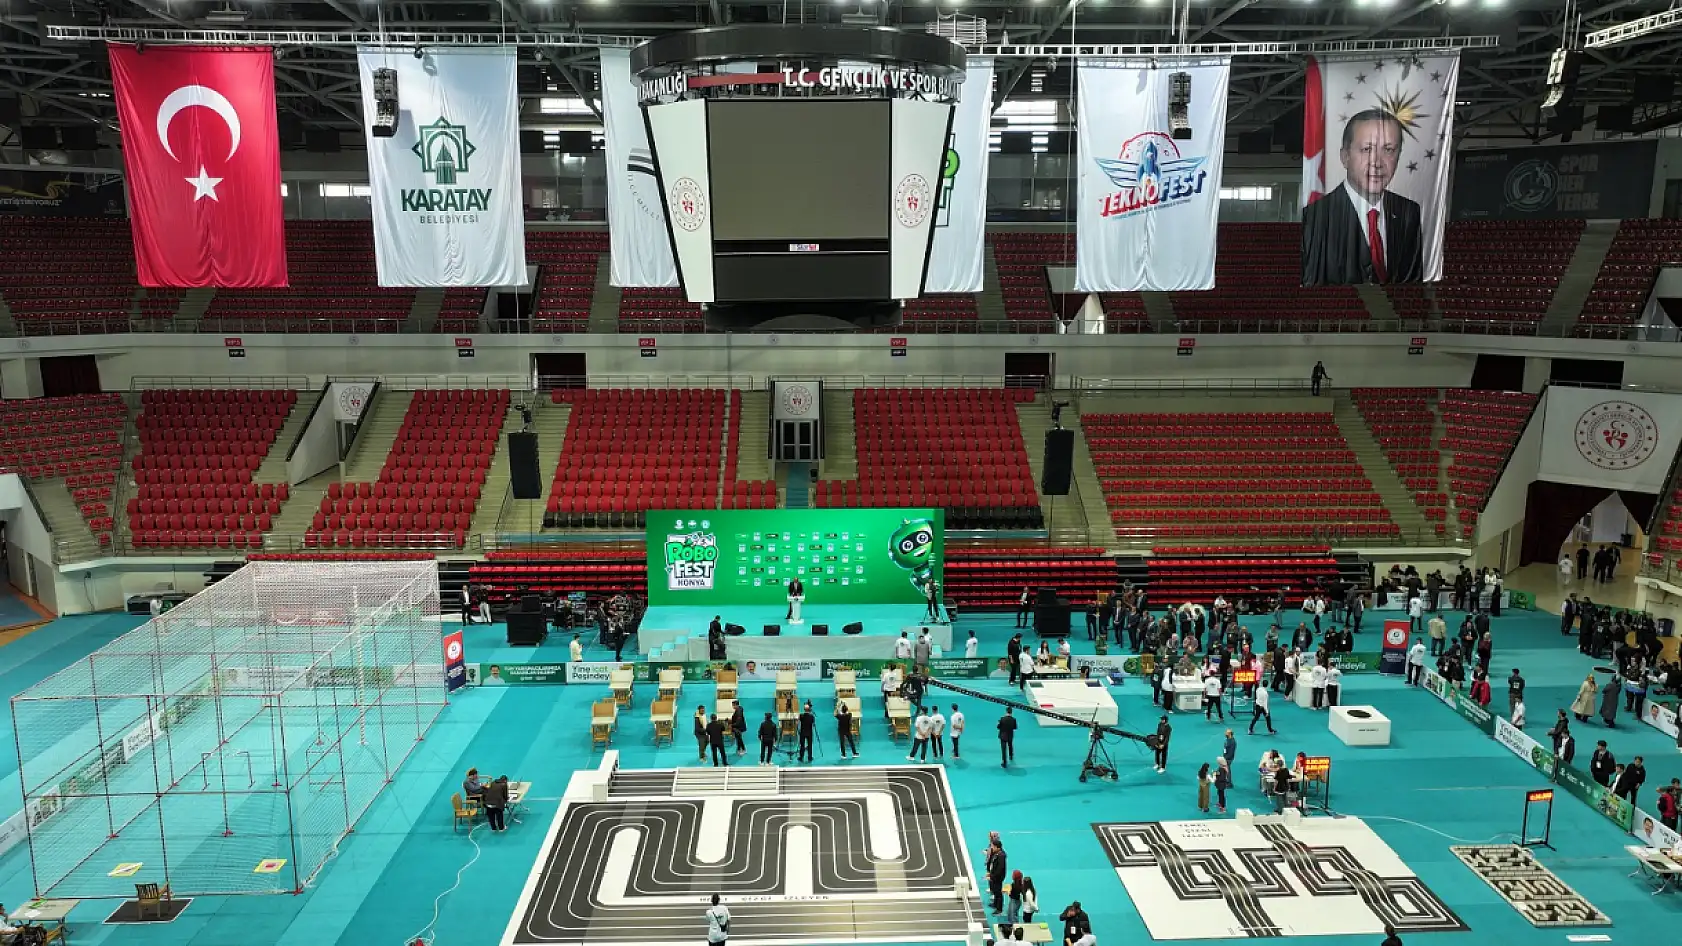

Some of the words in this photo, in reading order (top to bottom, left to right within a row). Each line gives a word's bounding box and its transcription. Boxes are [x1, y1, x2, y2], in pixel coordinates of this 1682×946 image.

[783, 68, 815, 87] T.C.
[819, 67, 888, 92] GENÇLİK
[891, 68, 906, 89] VE
[909, 73, 936, 95] SPOR
[400, 189, 492, 211] KARATAY
[1099, 169, 1206, 217] TEKNOFEST
[419, 213, 479, 224] BELEDİYESİ
[666, 542, 718, 565] ROBO
[674, 560, 714, 578] FEST
[572, 665, 591, 673] Yine
